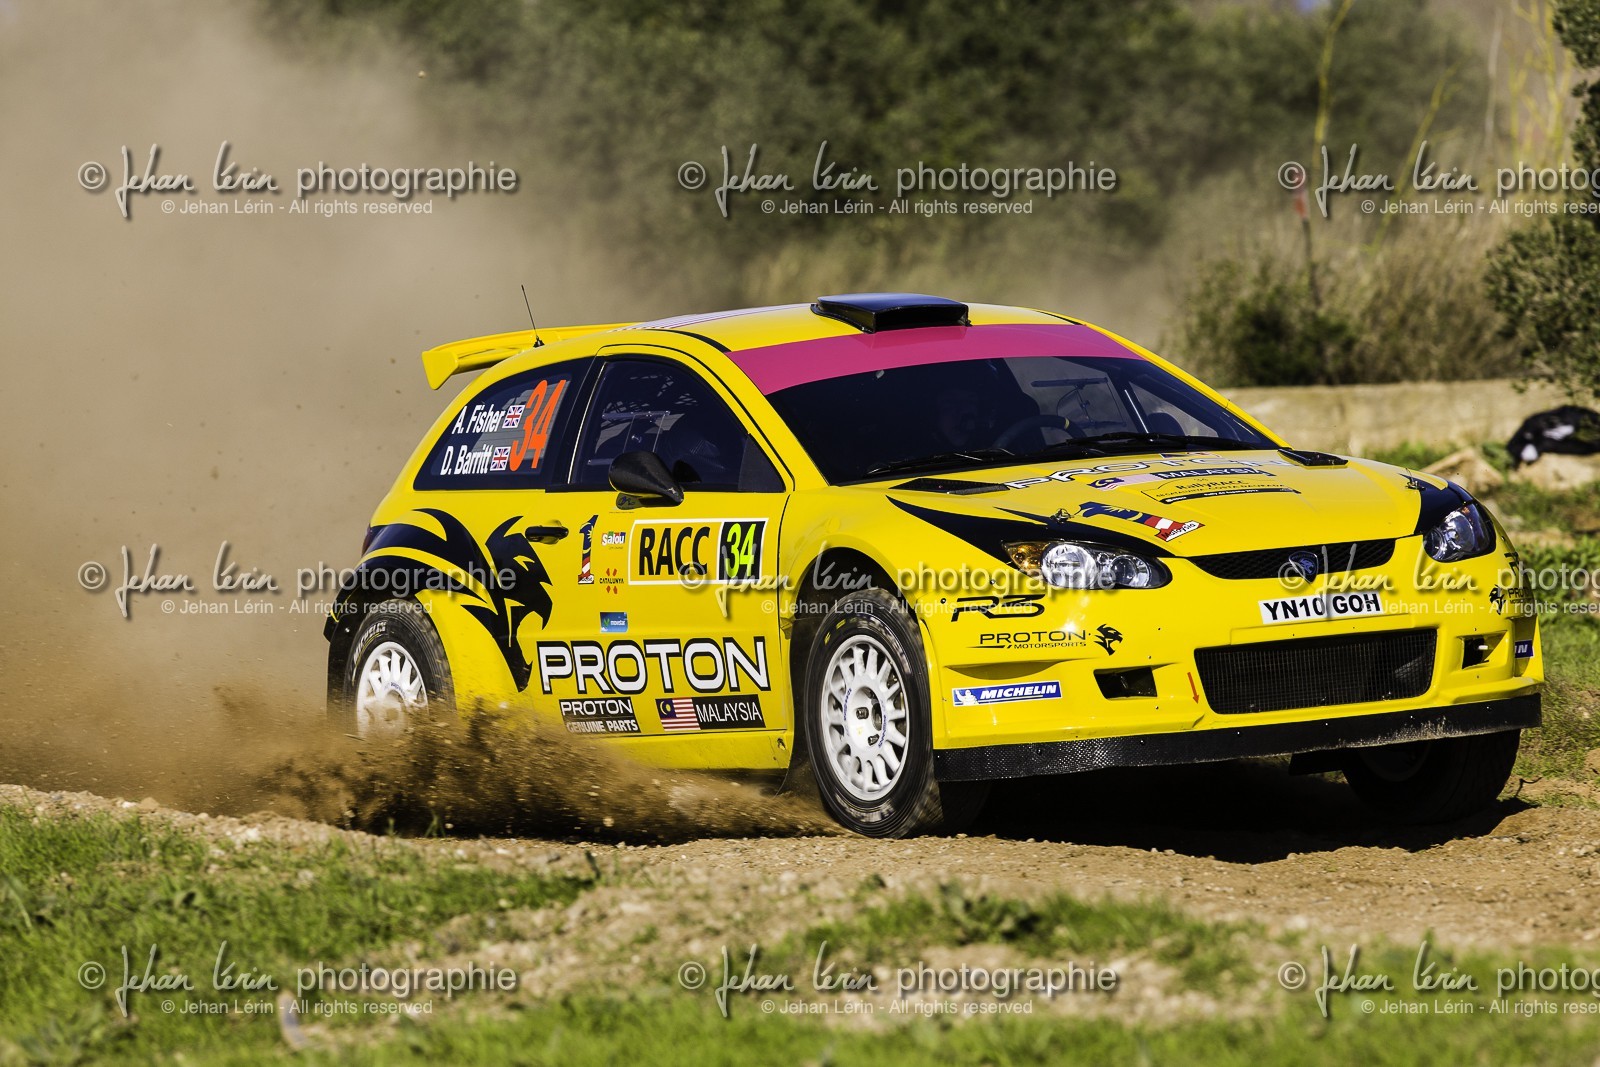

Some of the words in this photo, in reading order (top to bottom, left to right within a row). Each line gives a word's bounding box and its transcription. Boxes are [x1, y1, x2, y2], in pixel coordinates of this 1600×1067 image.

[451, 405, 467, 435] A.
[466, 403, 507, 434] Fisher
[509, 379, 566, 472] 34
[440, 445, 454, 476] D.
[454, 443, 493, 475] Barritt
[1004, 457, 1299, 489] PROTON
[1158, 467, 1273, 479] MALAYSIA
[602, 531, 626, 546] Salou
[638, 526, 711, 576] RACC
[725, 523, 757, 578] 34
[1263, 597, 1325, 621] YN10
[1332, 593, 1381, 614] GOH
[980, 629, 1086, 645] PROTON
[1012, 641, 1087, 649] MOTORSPORTS
[537, 637, 771, 695] PROTON
[980, 684, 1057, 700] MICHELIN
[560, 699, 634, 716] PROTON
[696, 701, 763, 723] MALAYSIA
[566, 719, 605, 733] GENUINE
[607, 719, 639, 732] PARTS
